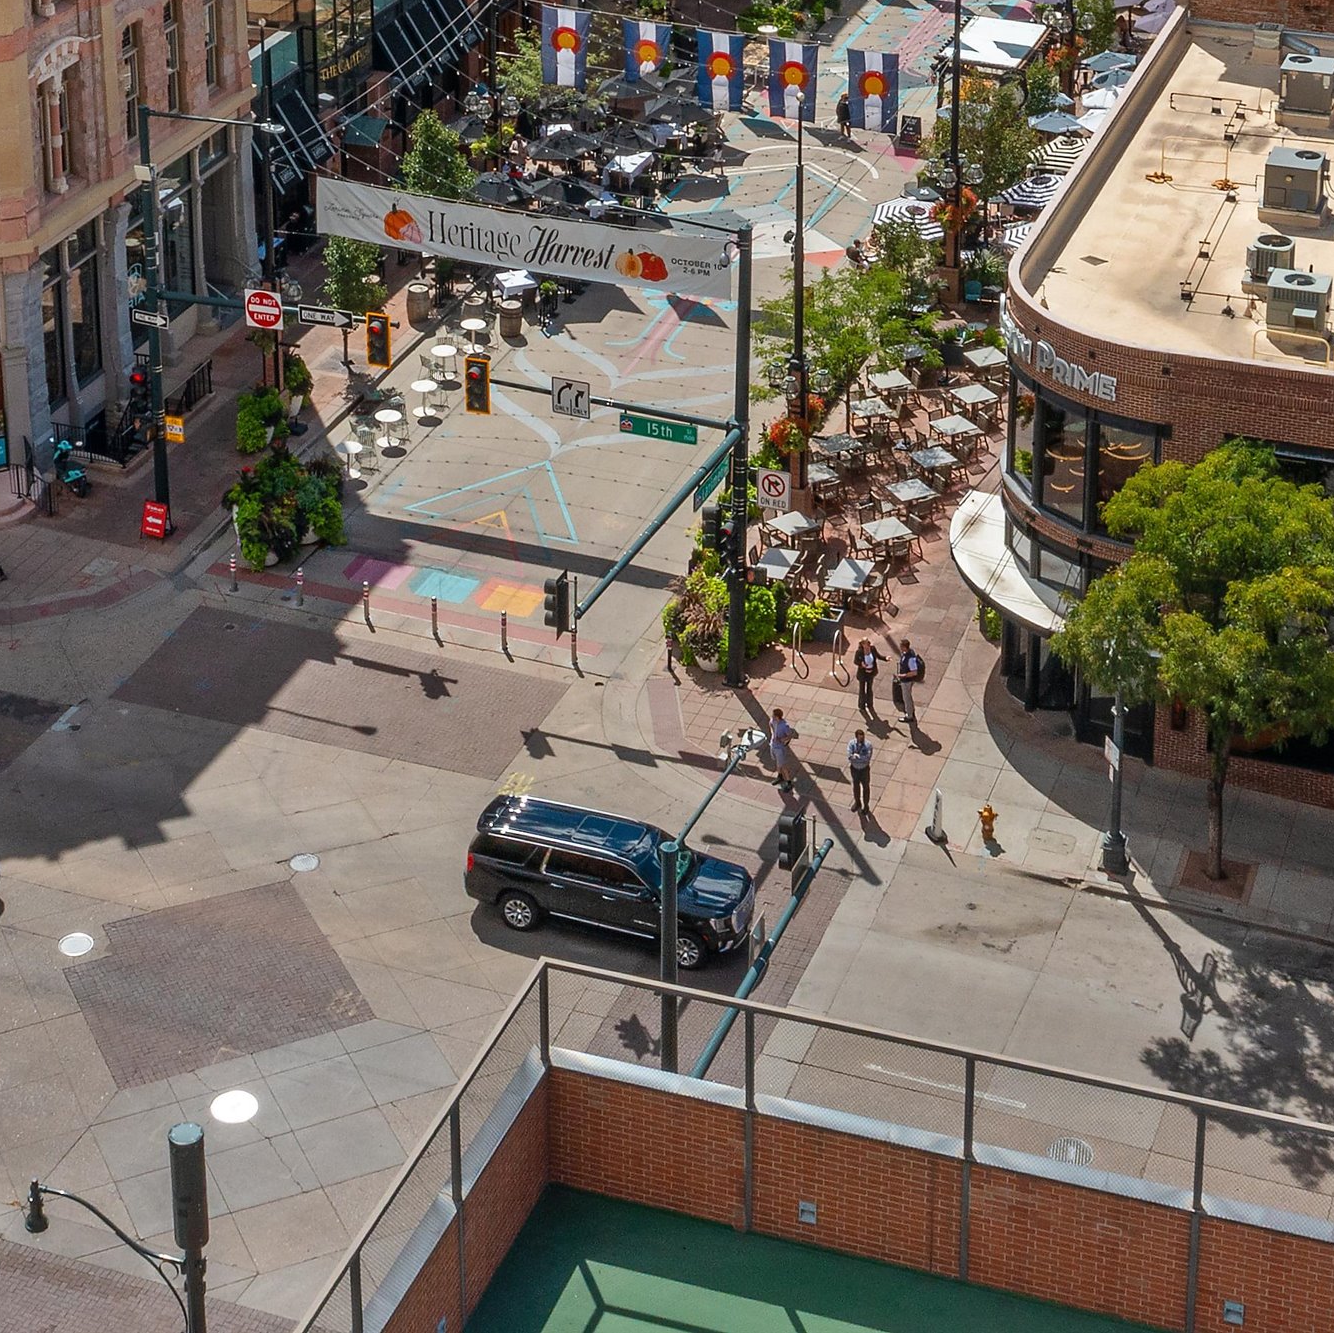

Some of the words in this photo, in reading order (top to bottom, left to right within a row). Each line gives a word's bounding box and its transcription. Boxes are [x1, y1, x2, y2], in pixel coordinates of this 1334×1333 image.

[428, 210, 521, 262] Heritage
[524, 225, 615, 270] Harvest
[671, 257, 711, 269] OCTOBER
[697, 268, 711, 277] PM
[250, 296, 259, 304] DO
[262, 298, 276, 307] NOT
[253, 313, 275, 321] ENTER
[303, 311, 317, 319] ONE
[320, 313, 335, 321] WAY
[1036, 339, 1117, 401] PRIME
[555, 404, 569, 414] ONLY
[647, 422, 673, 438] 15th
[760, 496, 770, 505] ON
[772, 499, 787, 508] RED
